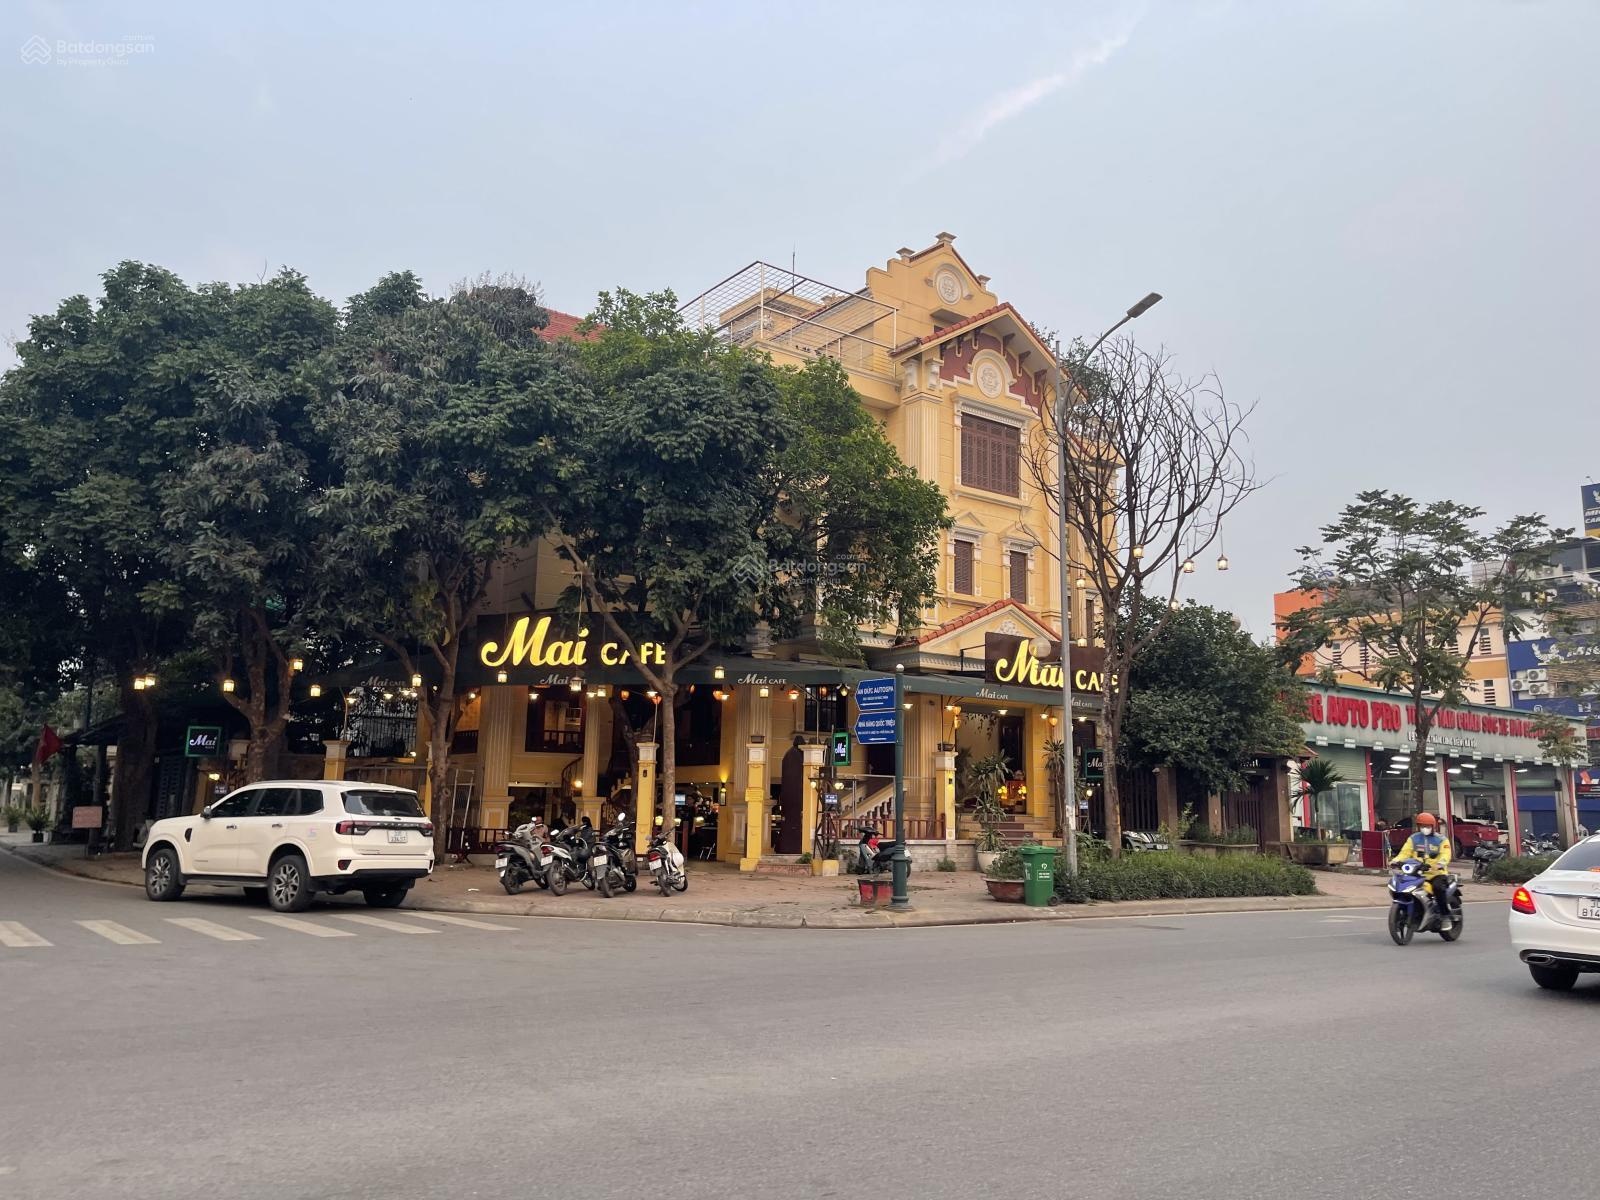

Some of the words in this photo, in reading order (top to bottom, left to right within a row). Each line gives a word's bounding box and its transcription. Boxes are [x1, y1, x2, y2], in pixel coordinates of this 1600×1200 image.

[480, 616, 589, 667] Mai
[540, 674, 569, 685] Mai
[737, 673, 768, 684] Mai
[976, 688, 996, 699] Mai
[1327, 695, 1369, 728] AUTO
[1371, 701, 1401, 731] PRO
[190, 735, 217, 745] Mai
[1088, 757, 1103, 768] Ma
